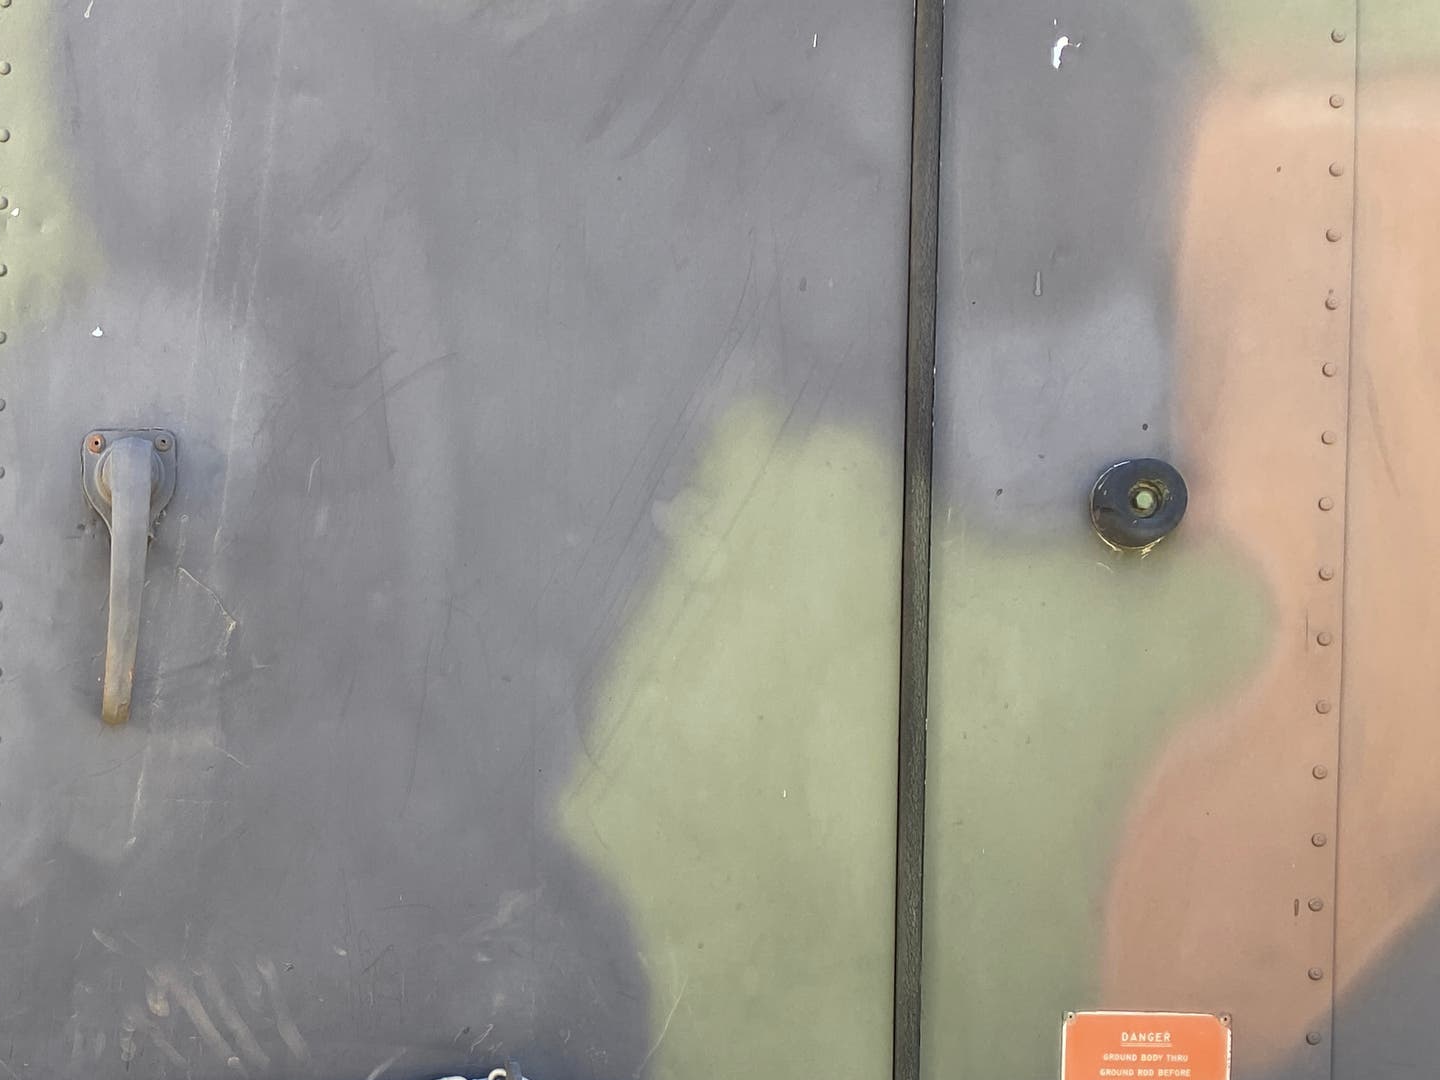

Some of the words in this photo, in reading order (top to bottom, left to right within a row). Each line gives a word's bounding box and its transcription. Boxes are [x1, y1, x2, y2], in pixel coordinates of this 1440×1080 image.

[1121, 1032, 1171, 1042] DANGER
[1103, 1053, 1137, 1061] GROUND
[1141, 1053, 1163, 1062] BODY
[1166, 1054, 1189, 1062] THRU
[1099, 1068, 1134, 1077] GROUND
[1137, 1068, 1154, 1077] ROD
[1158, 1068, 1191, 1077] BEFORE
